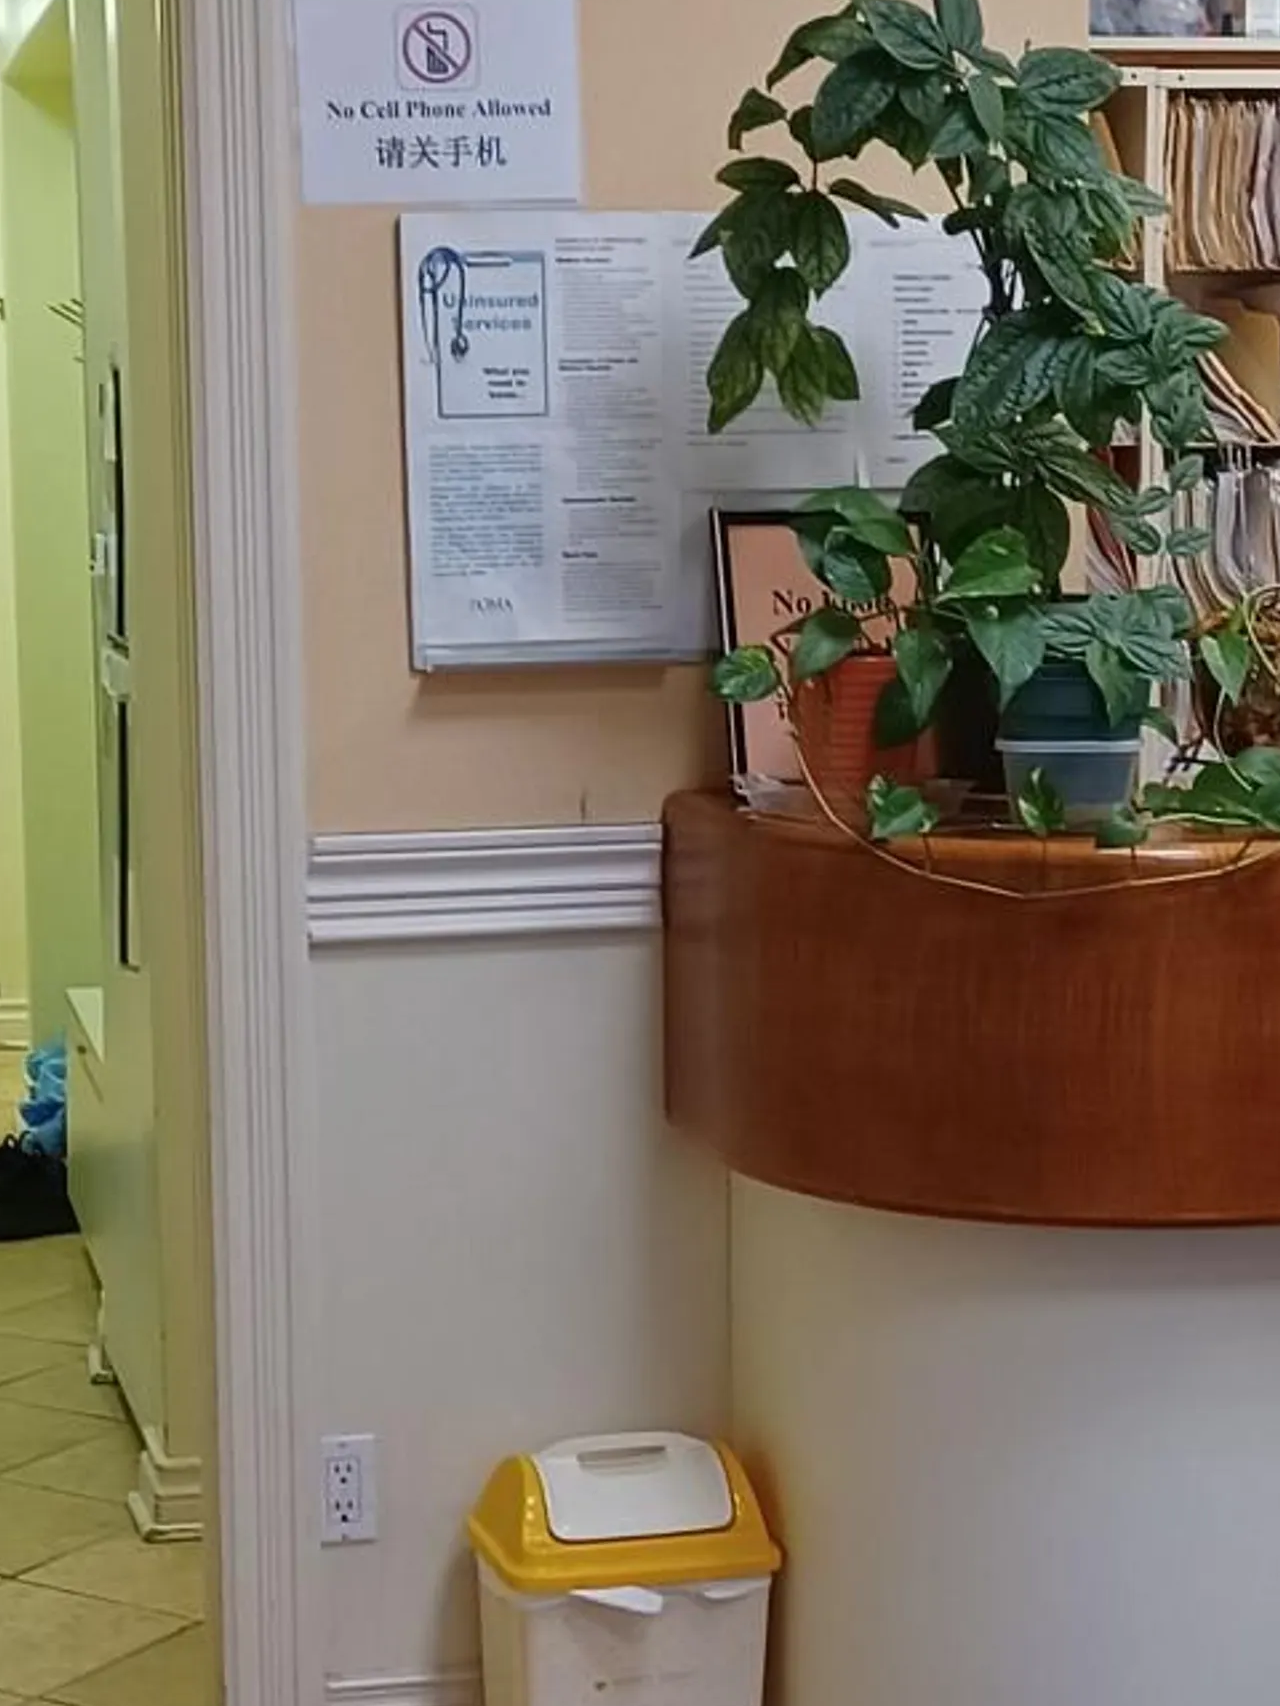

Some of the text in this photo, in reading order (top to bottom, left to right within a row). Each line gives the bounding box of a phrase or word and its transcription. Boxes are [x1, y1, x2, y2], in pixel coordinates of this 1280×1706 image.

[327, 97, 551, 120] No Cell Phone Allowed
[375, 135, 508, 169] 请关手机
[772, 590, 812, 616] No
